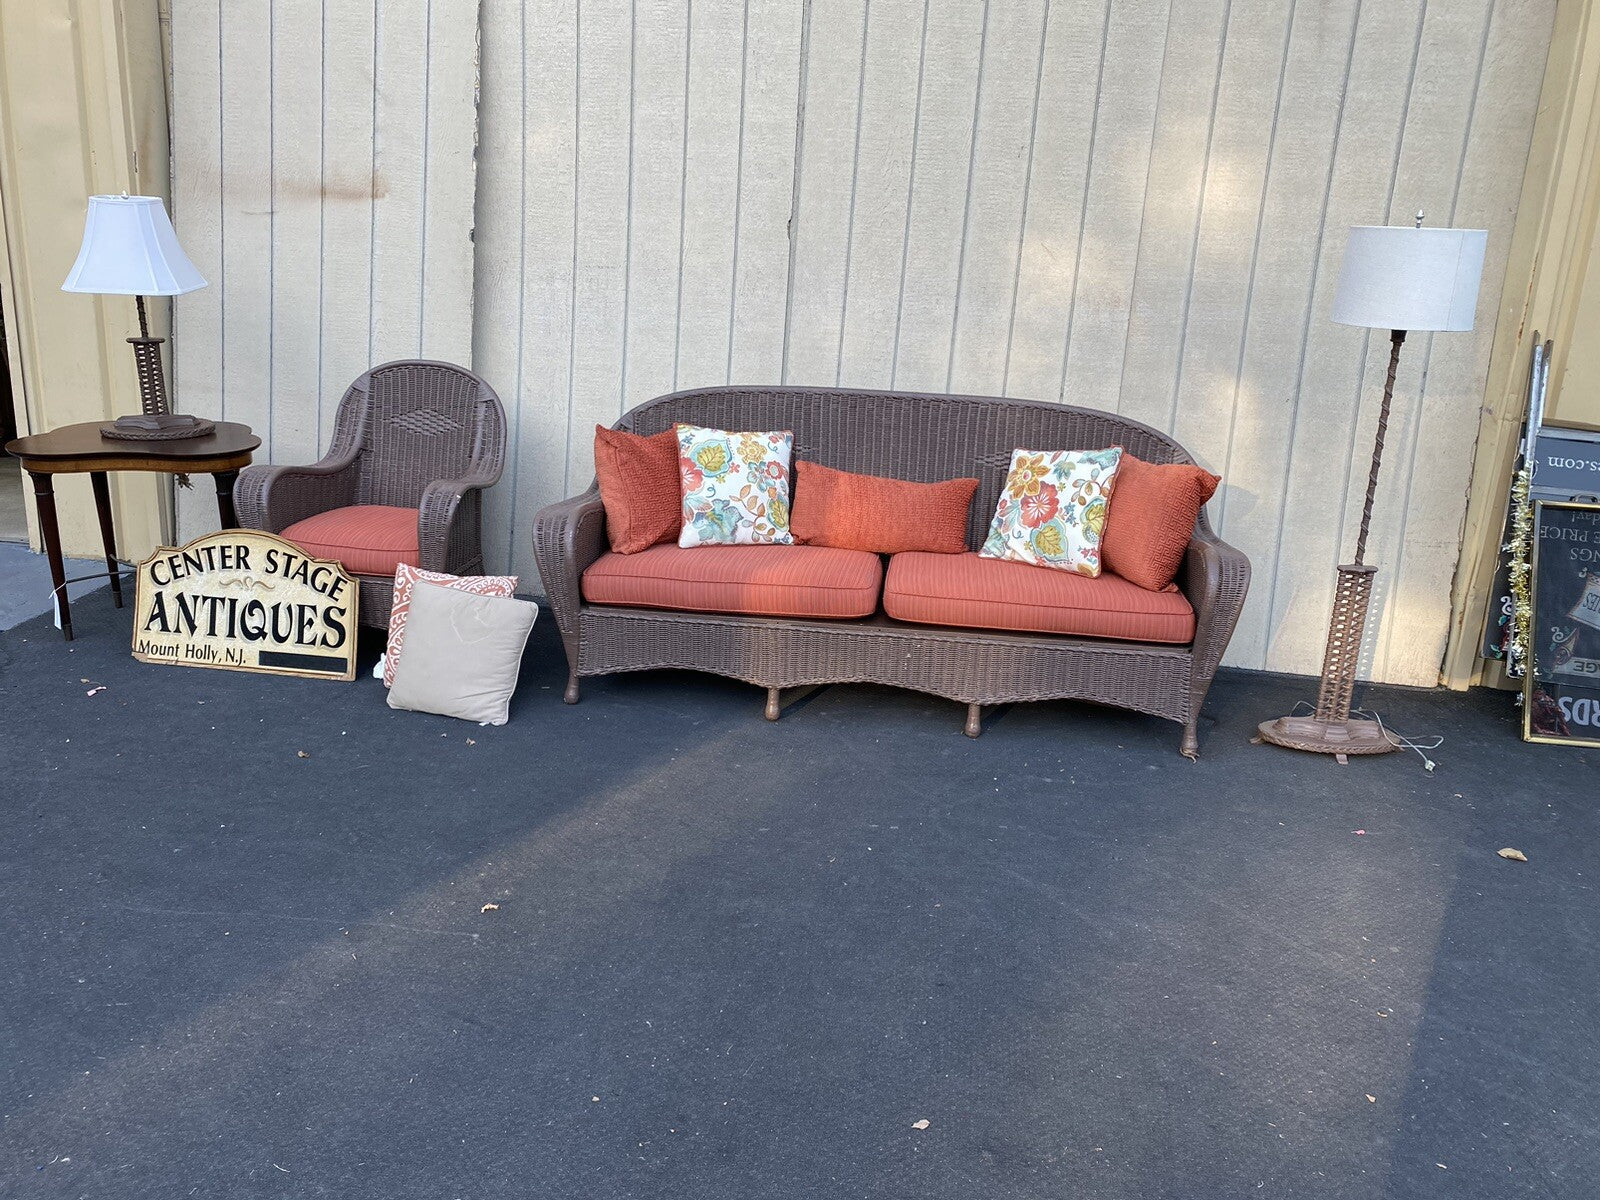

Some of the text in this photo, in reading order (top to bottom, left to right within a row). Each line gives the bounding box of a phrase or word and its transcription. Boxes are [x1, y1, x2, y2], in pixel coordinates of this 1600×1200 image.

[150, 545, 348, 602] CENTER STAGE
[144, 591, 346, 649] ANTIQUES
[138, 639, 246, 667] Mount Holly, N.J.
